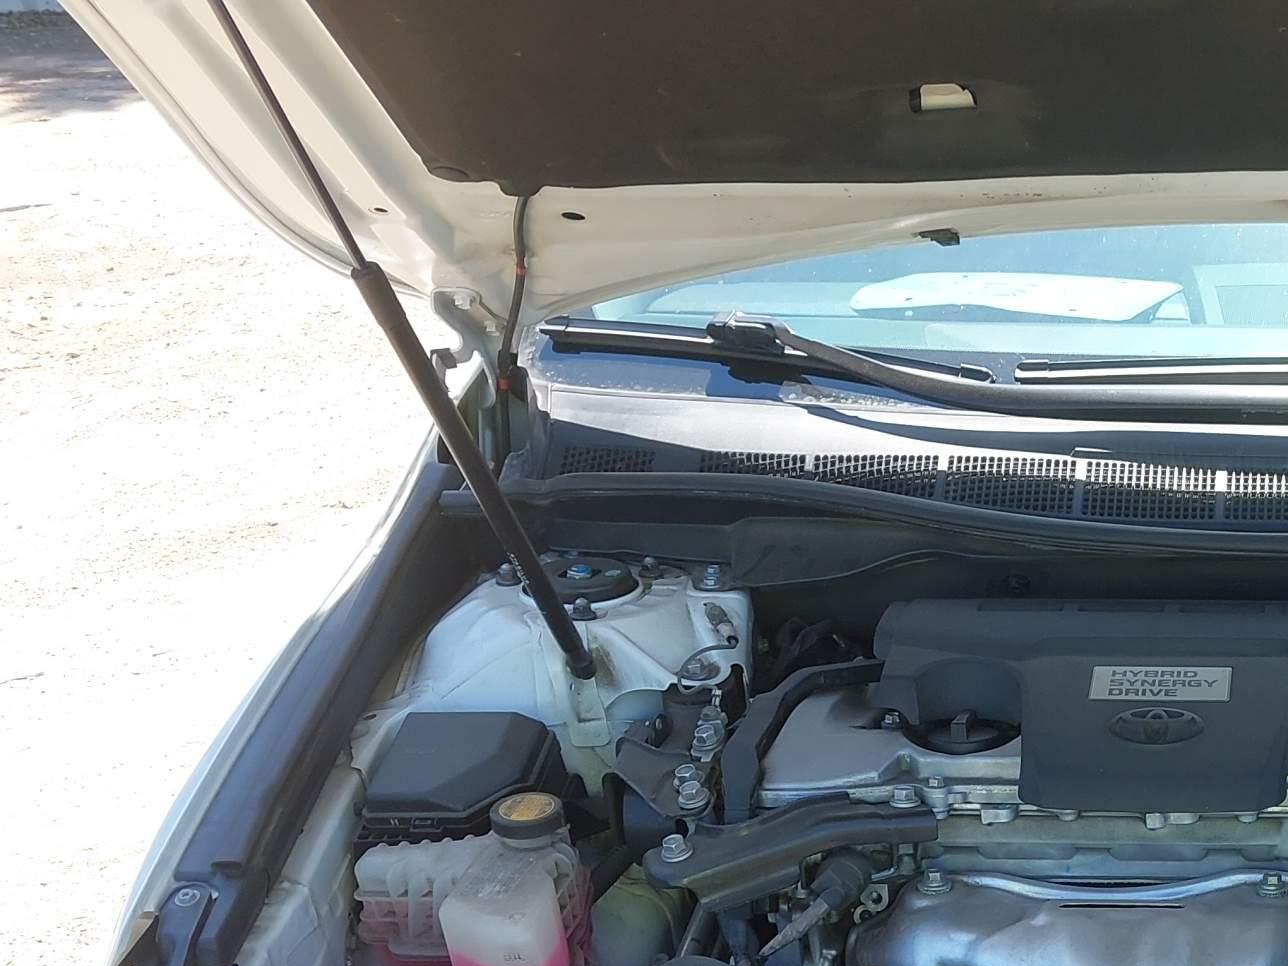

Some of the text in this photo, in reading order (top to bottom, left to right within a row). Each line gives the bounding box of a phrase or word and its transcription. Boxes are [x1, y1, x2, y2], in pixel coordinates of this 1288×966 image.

[1111, 669, 1198, 678] HYBRID
[1109, 678, 1219, 688] SYNERGY
[1107, 687, 1179, 697] DRIVE
